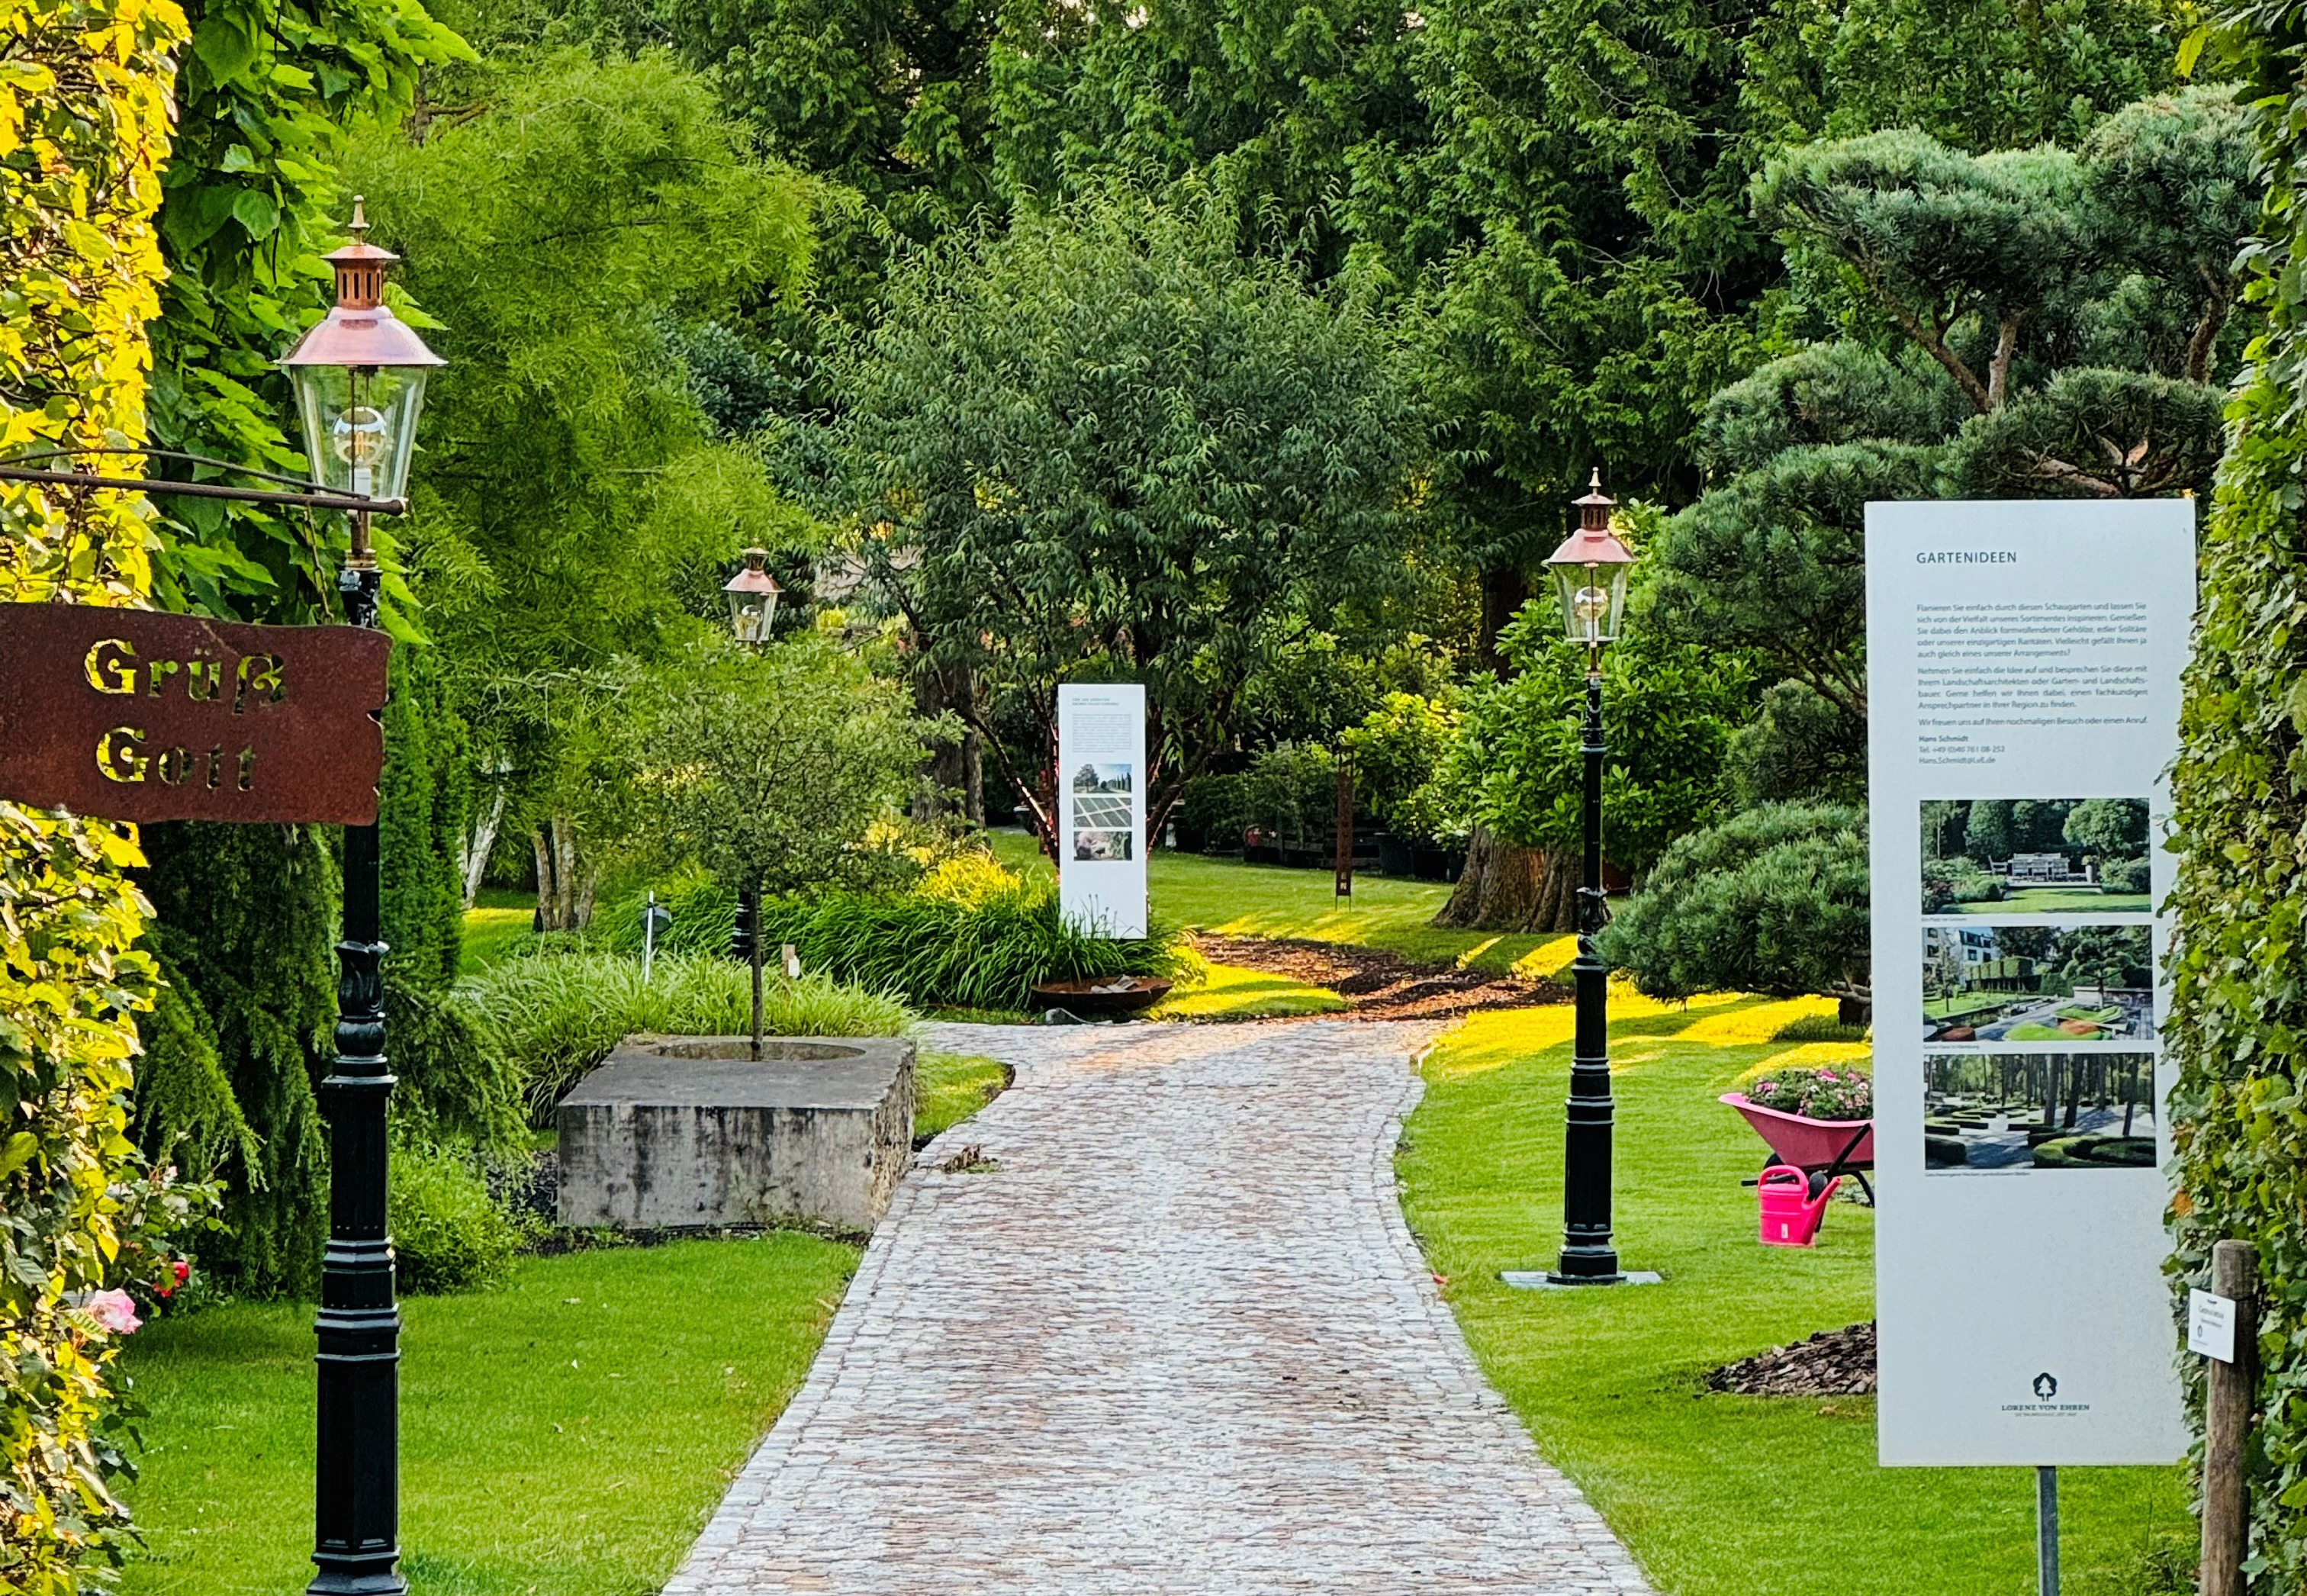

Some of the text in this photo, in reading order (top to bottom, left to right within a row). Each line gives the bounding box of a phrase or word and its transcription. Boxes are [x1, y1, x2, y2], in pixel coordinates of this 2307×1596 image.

[1916, 552, 2017, 563] GARTENIDEEN
[2018, 603, 2043, 611] diesen
[2044, 603, 2092, 611] Schaugarten
[1953, 626, 1968, 634] den
[1966, 638, 2016, 647] einzigartigen
[2139, 637, 2148, 645] ja
[1917, 650, 1936, 658] auch
[1937, 650, 1960, 659] gleich
[2025, 665, 2037, 674] auf
[2038, 665, 2053, 674] und
[2054, 665, 2099, 674] besprechen
[84, 637, 287, 716] Grüß
[1942, 677, 2029, 686] Landschaftsarchitekten
[1972, 689, 1997, 697] helfen
[2096, 688, 2148, 697] fachkundigen
[1918, 701, 1981, 710] Ansprechpartner
[2011, 700, 2038, 710] Region
[2006, 717, 2056, 726] nochmaligen
[2057, 716, 2084, 725] Besuch
[95, 726, 258, 792] Gott
